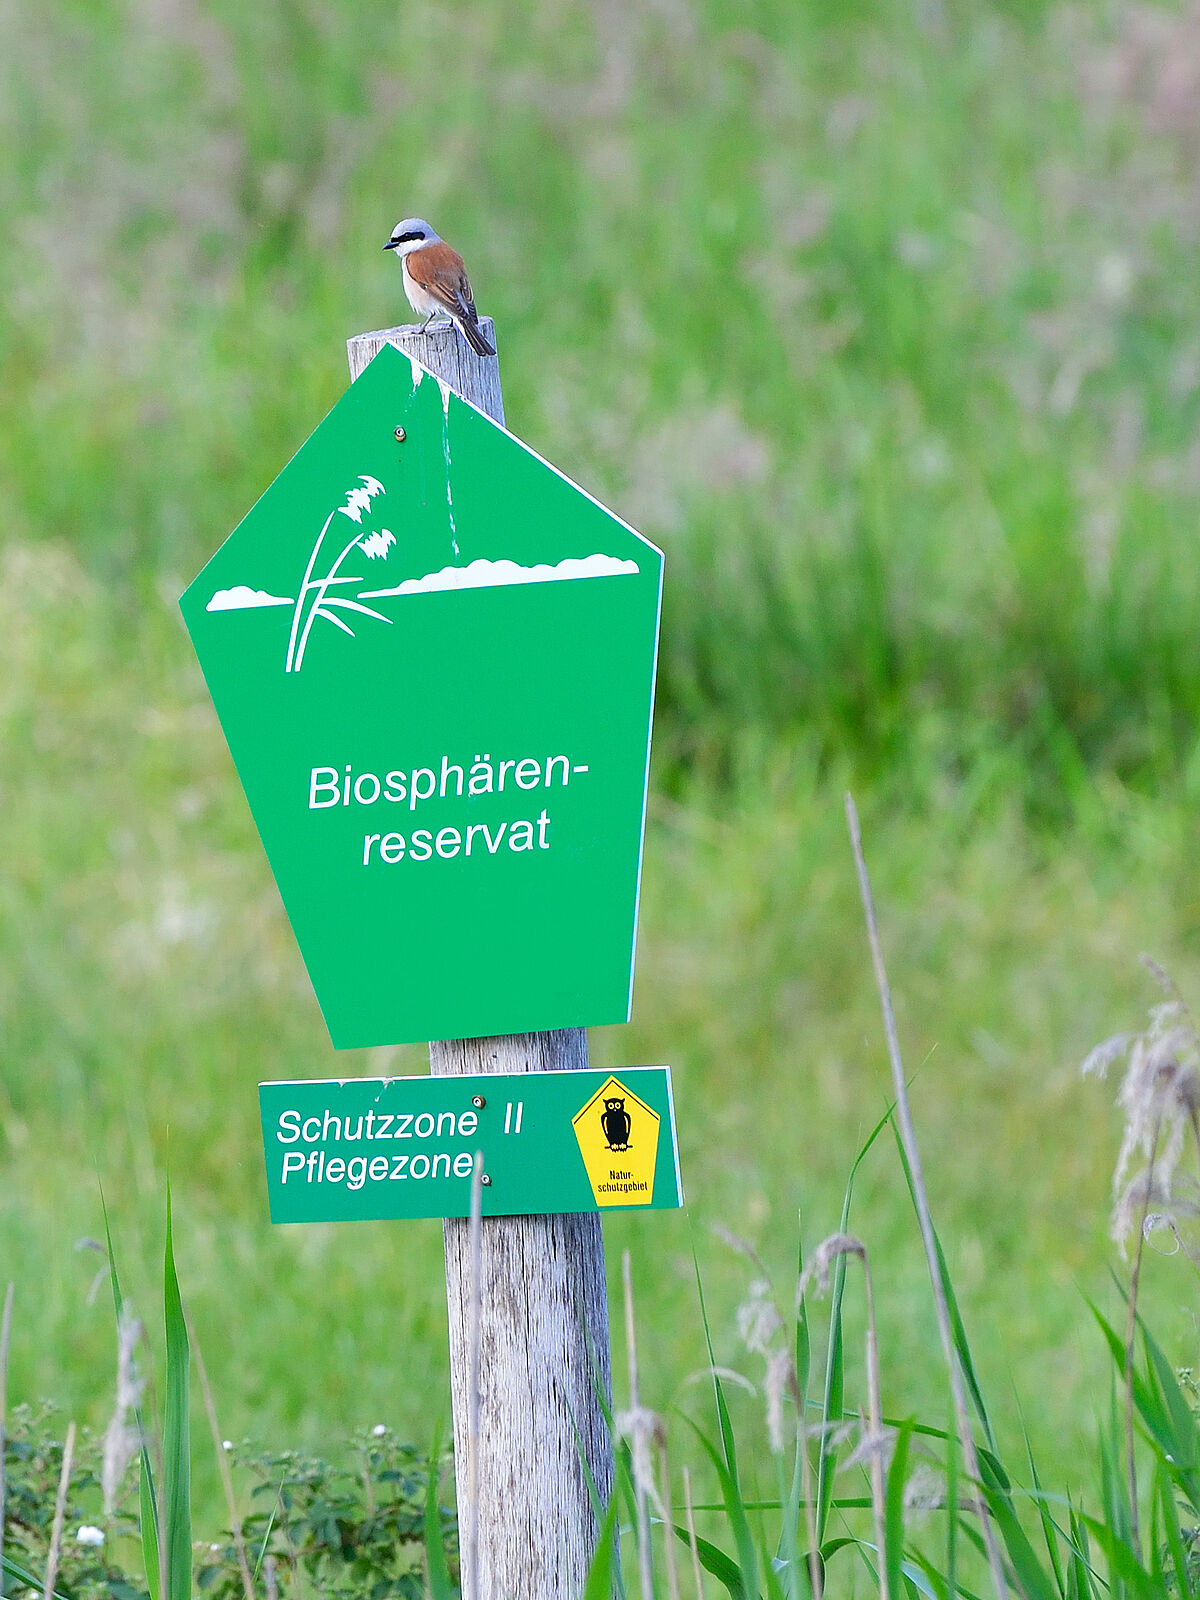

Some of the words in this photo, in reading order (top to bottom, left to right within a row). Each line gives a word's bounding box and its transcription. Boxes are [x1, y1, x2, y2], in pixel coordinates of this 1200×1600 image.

[308, 753, 590, 811] Biosphären-
[362, 808, 551, 866] reservat
[276, 1109, 479, 1143] Schutzzone
[503, 1102, 524, 1134] II
[280, 1150, 474, 1190] Pflegezone
[597, 1181, 648, 1193] schutzgebiet
[609, 1169, 634, 1180] Natur-
